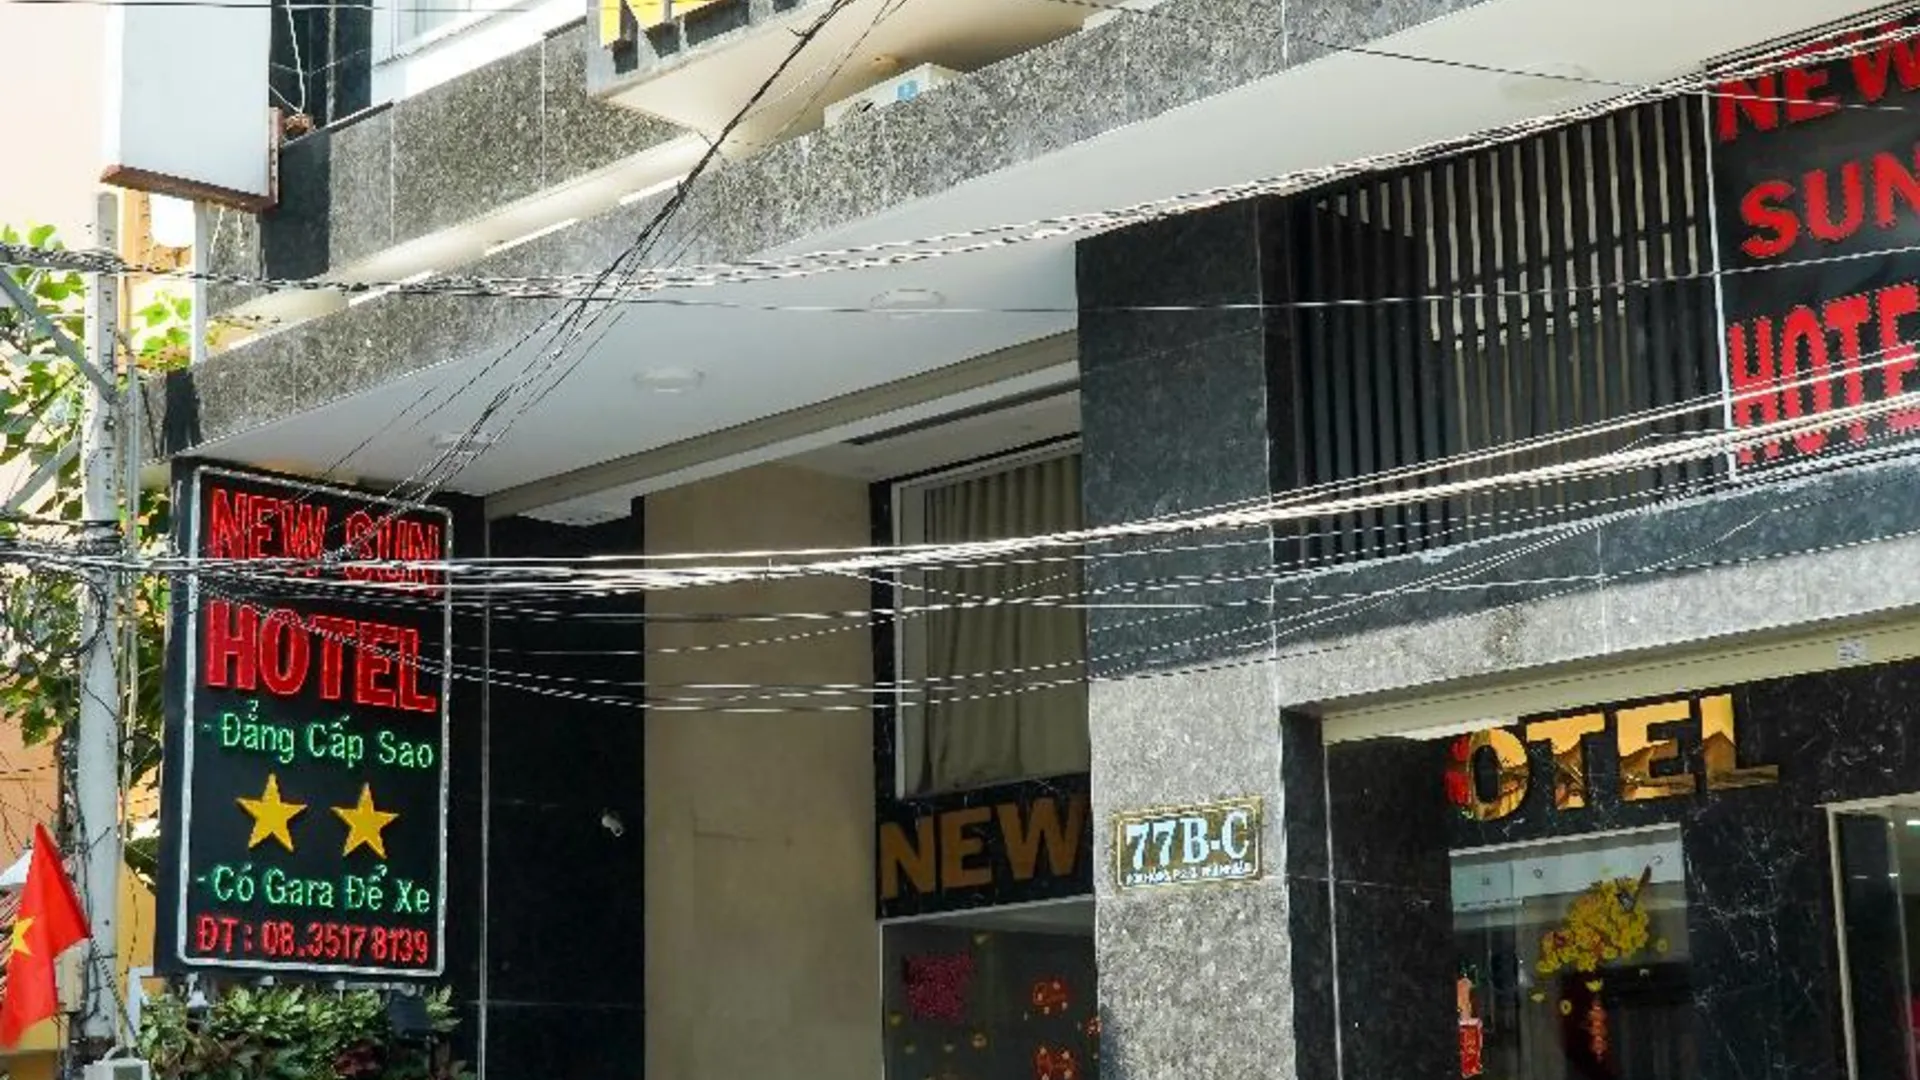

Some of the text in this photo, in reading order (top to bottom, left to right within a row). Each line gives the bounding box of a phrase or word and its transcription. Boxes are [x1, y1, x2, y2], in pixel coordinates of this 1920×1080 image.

[1717, 18, 1920, 143] NEW
[1740, 148, 1920, 259] SUN
[211, 487, 441, 597] NEW SUN
[205, 599, 438, 713] HOTEL
[308, 714, 363, 768] Cấp
[379, 730, 434, 768] Sao
[214, 863, 254, 901] Có
[265, 868, 334, 908] Gara
[346, 864, 387, 911] Để
[393, 879, 430, 913] Xe
[879, 796, 1088, 899] NEW
[1126, 810, 1249, 871] 77B-C
